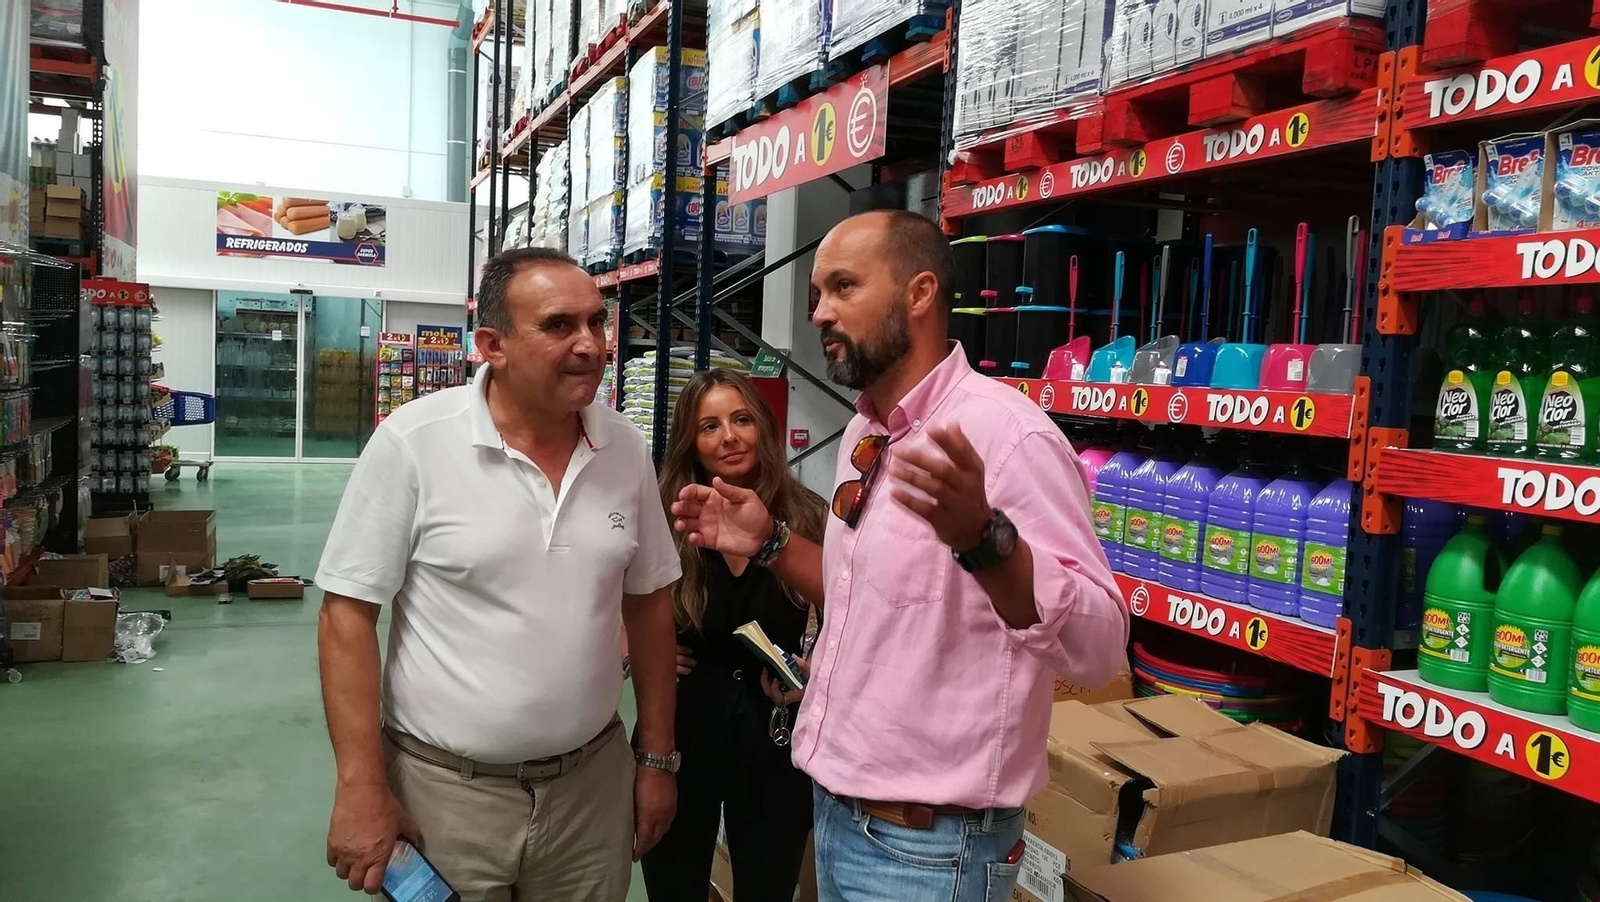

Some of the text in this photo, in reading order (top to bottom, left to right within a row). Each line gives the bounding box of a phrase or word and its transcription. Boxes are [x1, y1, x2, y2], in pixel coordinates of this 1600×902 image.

[1425, 59, 1542, 118] TODO
[1550, 63, 1573, 91] A
[733, 125, 790, 192] TODO
[794, 132, 807, 165] A
[813, 107, 834, 161] 1€
[972, 181, 1006, 208] TODO
[1007, 186, 1014, 200] A
[1070, 156, 1116, 189] TODO
[1117, 161, 1126, 176] A
[1203, 123, 1266, 163] TODO
[1269, 131, 1281, 147] A
[226, 237, 309, 253] REFRIGERADOS
[1516, 238, 1600, 279] TOD
[1071, 386, 1116, 413] TODO
[1119, 398, 1127, 410] A
[1206, 394, 1269, 425] TODO
[1273, 406, 1285, 423] A
[1442, 403, 1467, 417] Clor
[1443, 391, 1468, 406] Neo
[1493, 393, 1515, 406] Neo
[1545, 395, 1573, 410] Neo
[1492, 405, 1515, 420] Clor
[1544, 407, 1572, 422] Clor
[1497, 467, 1600, 515] TODO
[1167, 594, 1225, 636] TODO
[1229, 621, 1240, 639] A
[1578, 652, 1600, 664] BOO
[1378, 682, 1565, 776] TODO A 1€
